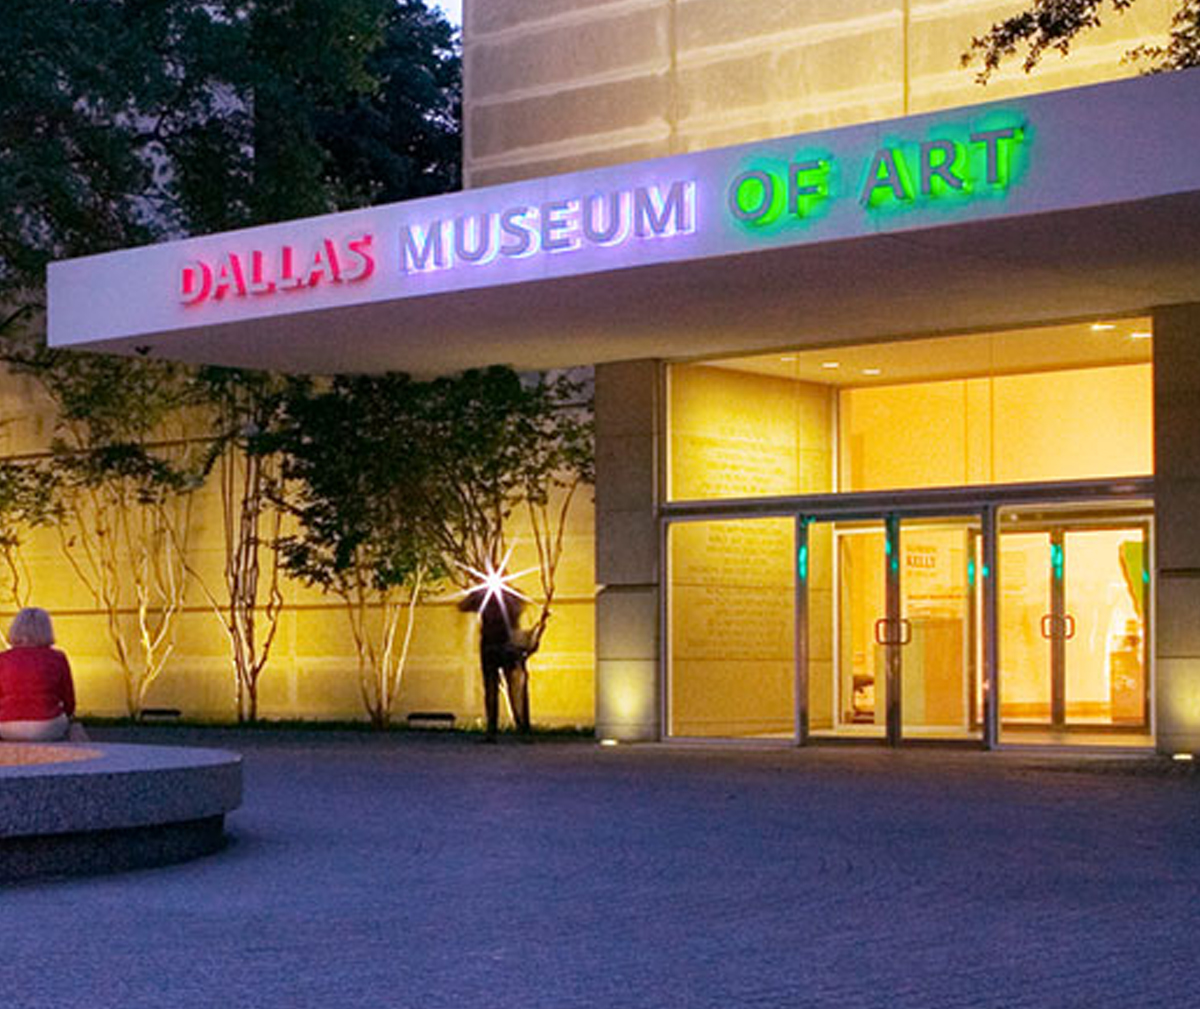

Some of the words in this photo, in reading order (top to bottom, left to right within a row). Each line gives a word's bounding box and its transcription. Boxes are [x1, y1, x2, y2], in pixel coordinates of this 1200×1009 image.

[179, 234, 374, 304] DALLAS
[400, 181, 695, 274] MUSEUM
[729, 158, 830, 226] OF
[859, 126, 1024, 208] ART
